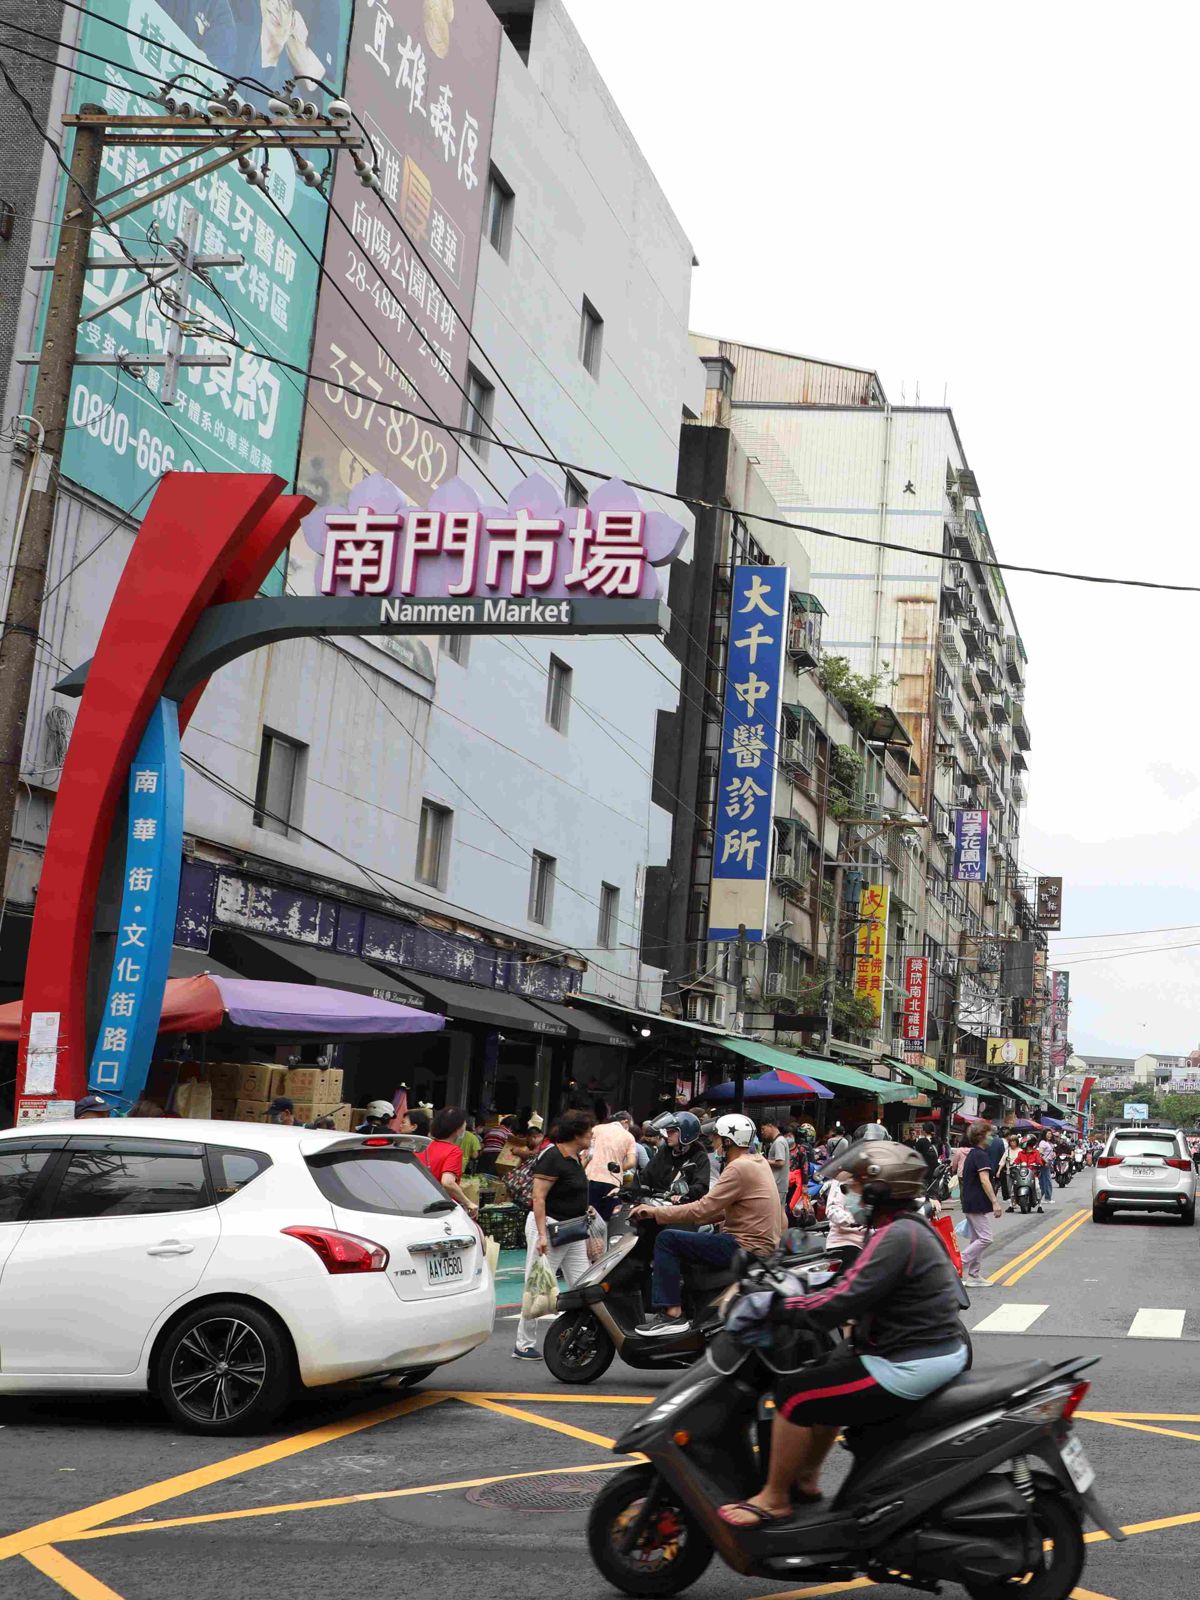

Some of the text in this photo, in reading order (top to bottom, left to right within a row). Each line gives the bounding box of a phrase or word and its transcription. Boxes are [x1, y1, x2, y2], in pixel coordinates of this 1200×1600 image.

[324, 342, 448, 491] 337-8282
[321, 507, 648, 597] 南門市場
[380, 599, 570, 624] Nanmen Market
[720, 575, 780, 872] 大千中醫診所
[959, 862, 981, 871] KTV
[907, 959, 923, 1038] 榮欣南北雜貨
